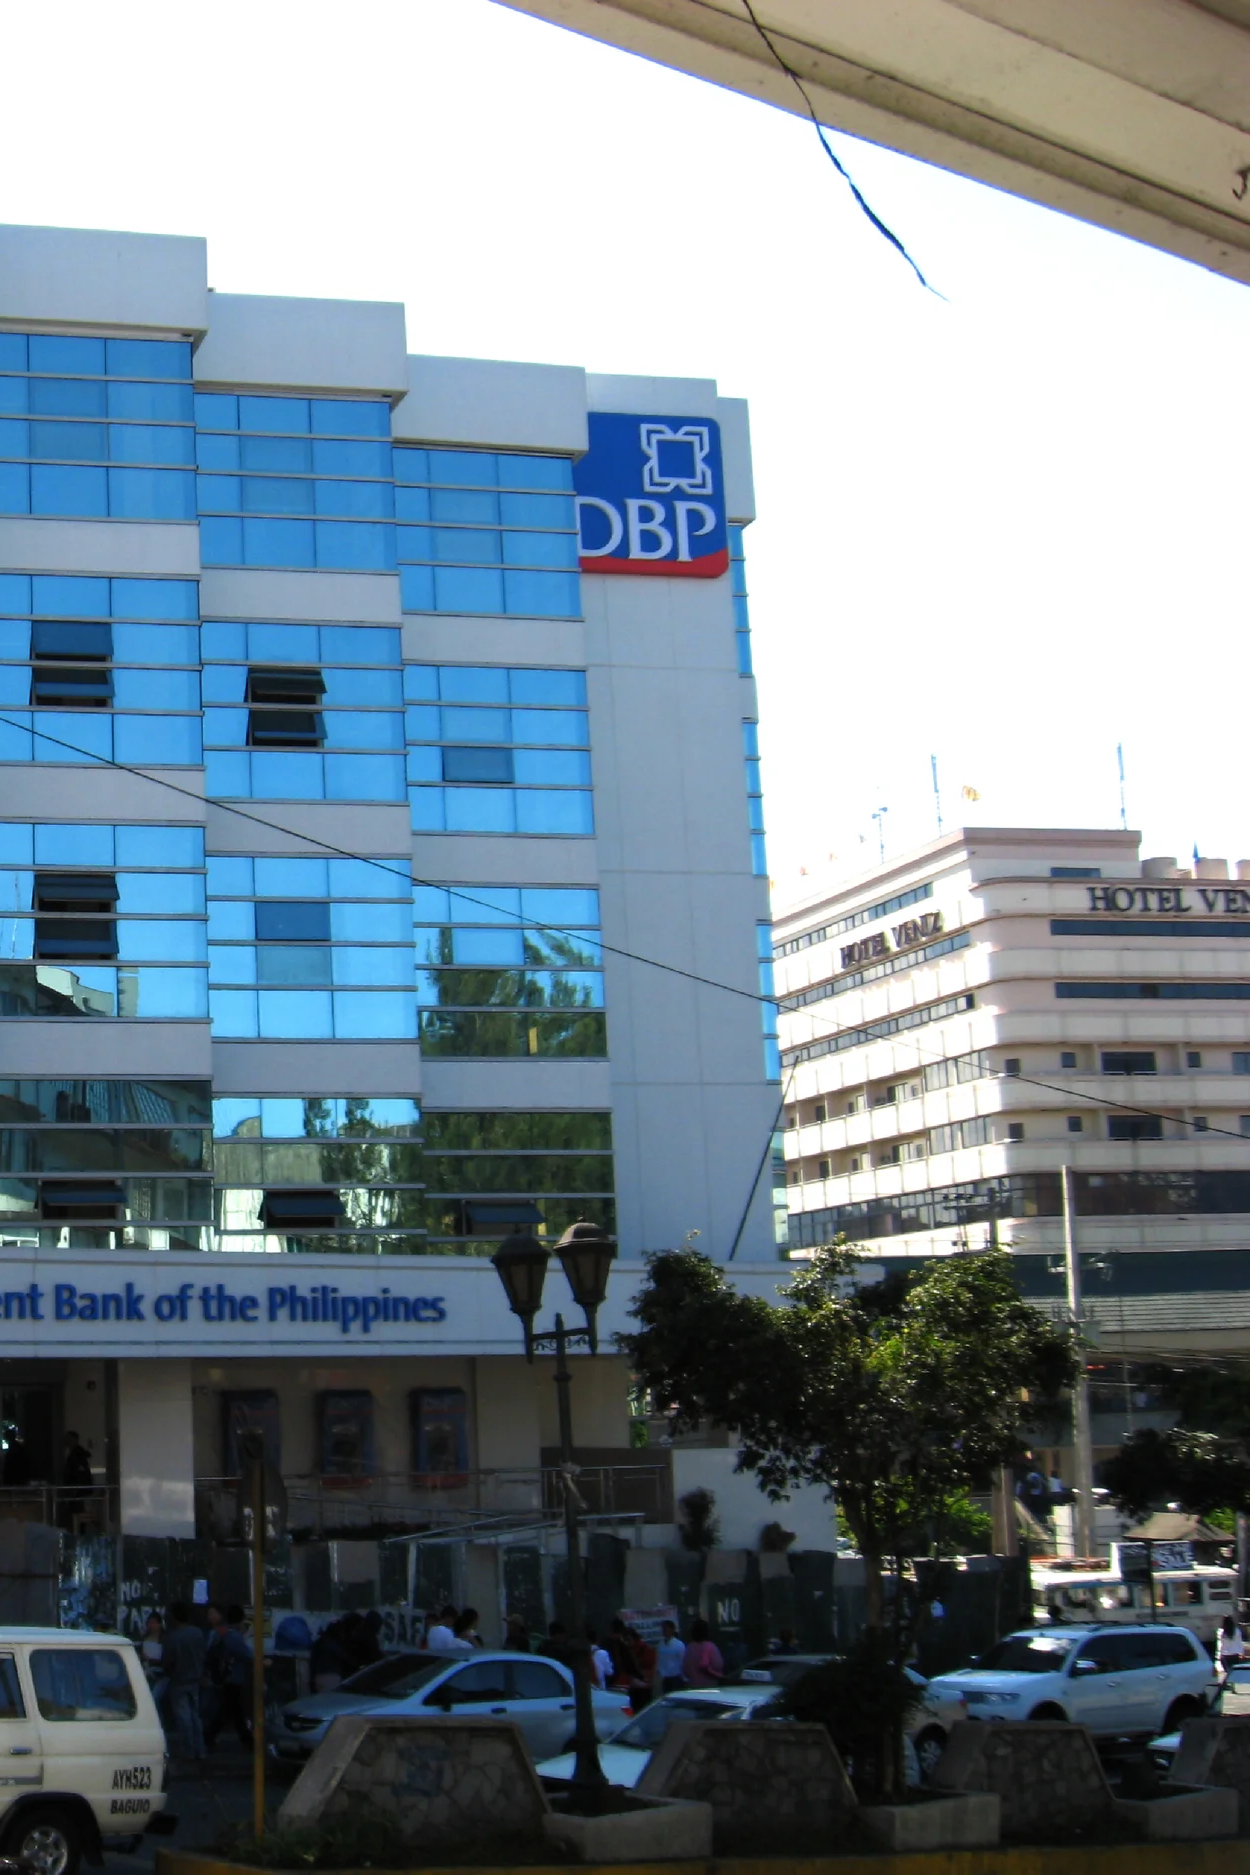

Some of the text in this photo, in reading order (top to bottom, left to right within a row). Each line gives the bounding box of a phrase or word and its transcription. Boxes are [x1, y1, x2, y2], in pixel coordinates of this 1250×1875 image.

[574, 495, 717, 562] DBP
[1086, 886, 1191, 913] HOTEL
[840, 932, 890, 969] HOTEL
[54, 1281, 146, 1322] Bank
[153, 1283, 195, 1322] of
[199, 1283, 260, 1323] the
[267, 1284, 448, 1335] Philippines
[120, 1579, 141, 1602] NO
[717, 1598, 740, 1624] NO
[110, 1798, 151, 1815] BAGUIO
